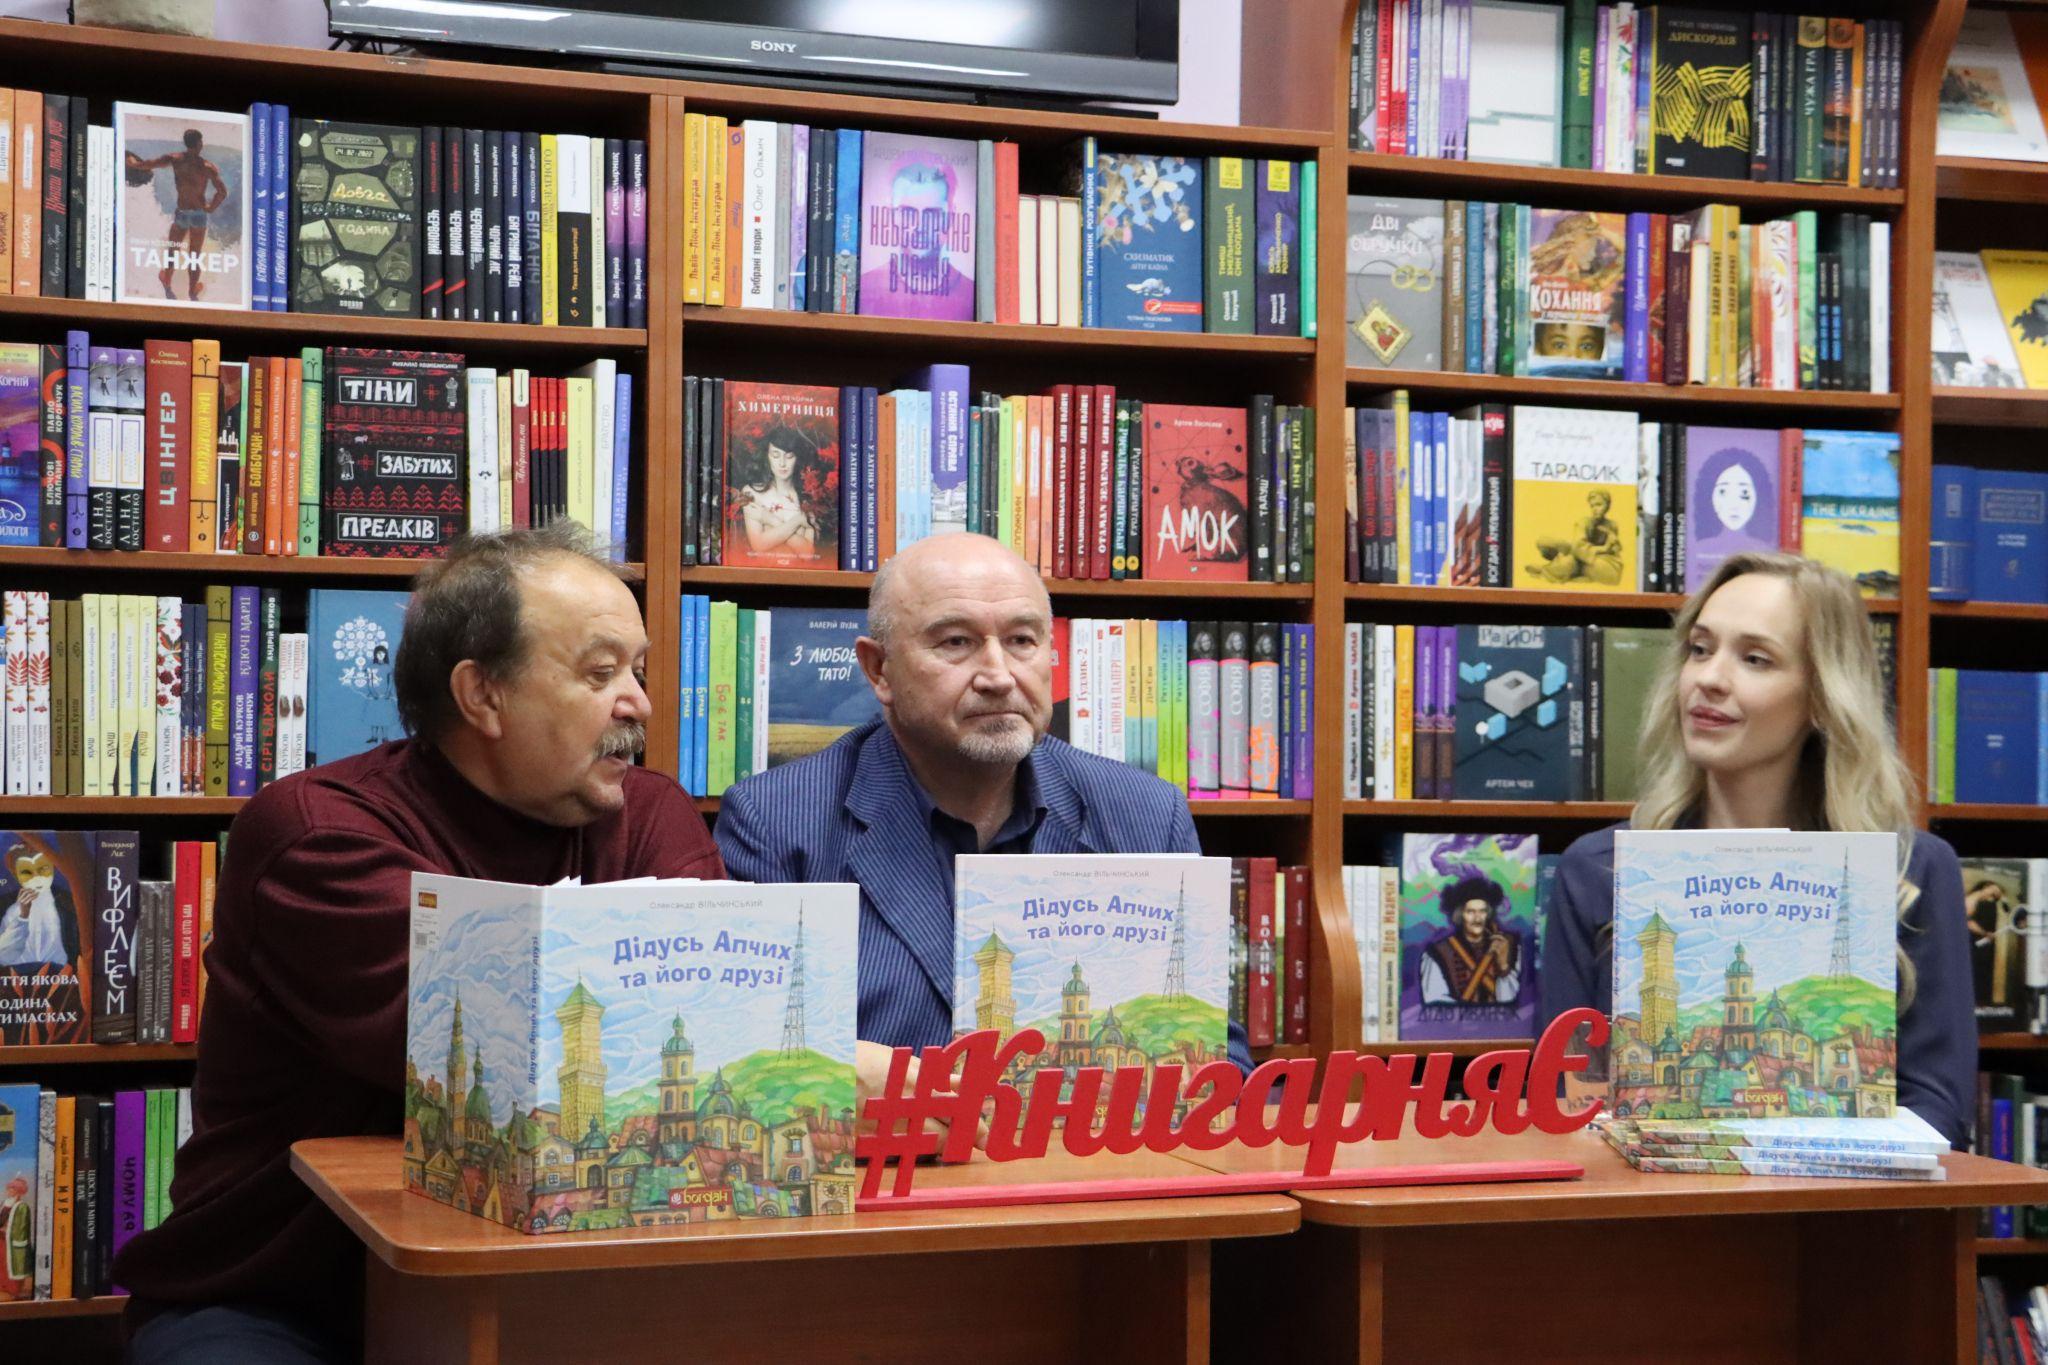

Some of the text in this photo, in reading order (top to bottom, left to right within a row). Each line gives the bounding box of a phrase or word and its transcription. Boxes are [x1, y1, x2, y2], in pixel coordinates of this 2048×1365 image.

[750, 39, 797, 54] SONY
[1668, 32, 1737, 46] ДИСКОРДІЯ
[750, 138, 764, 294] Вибрані твори Олег Ольжич
[1371, 215, 1398, 231] ДВІ
[427, 210, 441, 254] ЧЕРВОНИЙ
[449, 211, 464, 256] ЧЕРВОНИЙ
[470, 208, 483, 253] ЧЕРВОНИЙ
[130, 246, 240, 273] ТАНЖЕР
[489, 226, 502, 275] ЧОРНИЙ ЛІС
[508, 216, 521, 288] БАГРЯНИЙ РЕЙД
[526, 210, 540, 284] БІЛА НІЧ
[1531, 286, 1601, 311] КОХАННЯ
[345, 378, 414, 403] ТІНИ
[47, 400, 55, 432] ПАВЛО
[55, 384, 63, 432] КОРОБЧУК
[737, 400, 836, 417] ХИМЕРНИЦЯ
[381, 456, 454, 475] ЗАБУТИХ
[948, 435, 957, 471] СПРАВА
[1530, 462, 1622, 482] ТАРАСИК
[93, 492, 103, 543] ЛІНА
[105, 491, 113, 544] КОСТЕНКО
[120, 494, 130, 544] ЛІНА
[132, 493, 140, 545] КОСТЕНКО
[1811, 503, 1897, 519] THE UKRAINE
[342, 516, 435, 539] ПРЕДКІВ
[1099, 505, 1107, 553] ОТАМАН
[1157, 505, 1239, 561] АМОК
[267, 597, 275, 661] АНДРІЙ КУРКОВ
[809, 621, 838, 629] ВАЛЕРІЙ
[239, 635, 251, 676] КЛЮЧІ
[790, 645, 803, 666] З
[818, 667, 852, 681] ТАТО!
[1111, 659, 1120, 733] КІНО НА ПАПЕРІ
[234, 695, 244, 766] АНДРІЙ КУРКОВ
[244, 693, 254, 769] ЮРІЙ ВИННИЧУК
[262, 671, 275, 772] СІРІ БДЖОЛИ
[1485, 780, 1534, 788] АРТЕМ ЧЕХ
[1684, 872, 1839, 899] Дідусь Апчих
[649, 899, 763, 910] Олександр ВІЛЬЧИНСЬКИЙ
[1022, 895, 1175, 922] Дідусь Апчих
[1689, 899, 1831, 922] та його друзі
[1027, 920, 1167, 944] та його друзі
[531, 936, 539, 965] друзі
[613, 930, 792, 965] Дідусь Апчих
[1260, 915, 1272, 987] ВОЛИНЬ
[31, 974, 79, 986] ЯКОВА
[619, 962, 784, 989] та його друзі
[15, 1011, 78, 1024] МАСКАХ
[531, 997, 536, 1010] та
[529, 1013, 537, 1045] Апчих
[528, 1049, 537, 1085] Дідусь
[855, 1007, 1610, 1198] #КнигарняЄ
[1758, 1150, 1892, 1165] Дідусь Апчих та його друзі
[1772, 1138, 1905, 1152] Дідусь Апчих та його друзі
[1770, 1163, 1804, 1173] Дідусь
[57, 1186, 68, 1214] МУР
